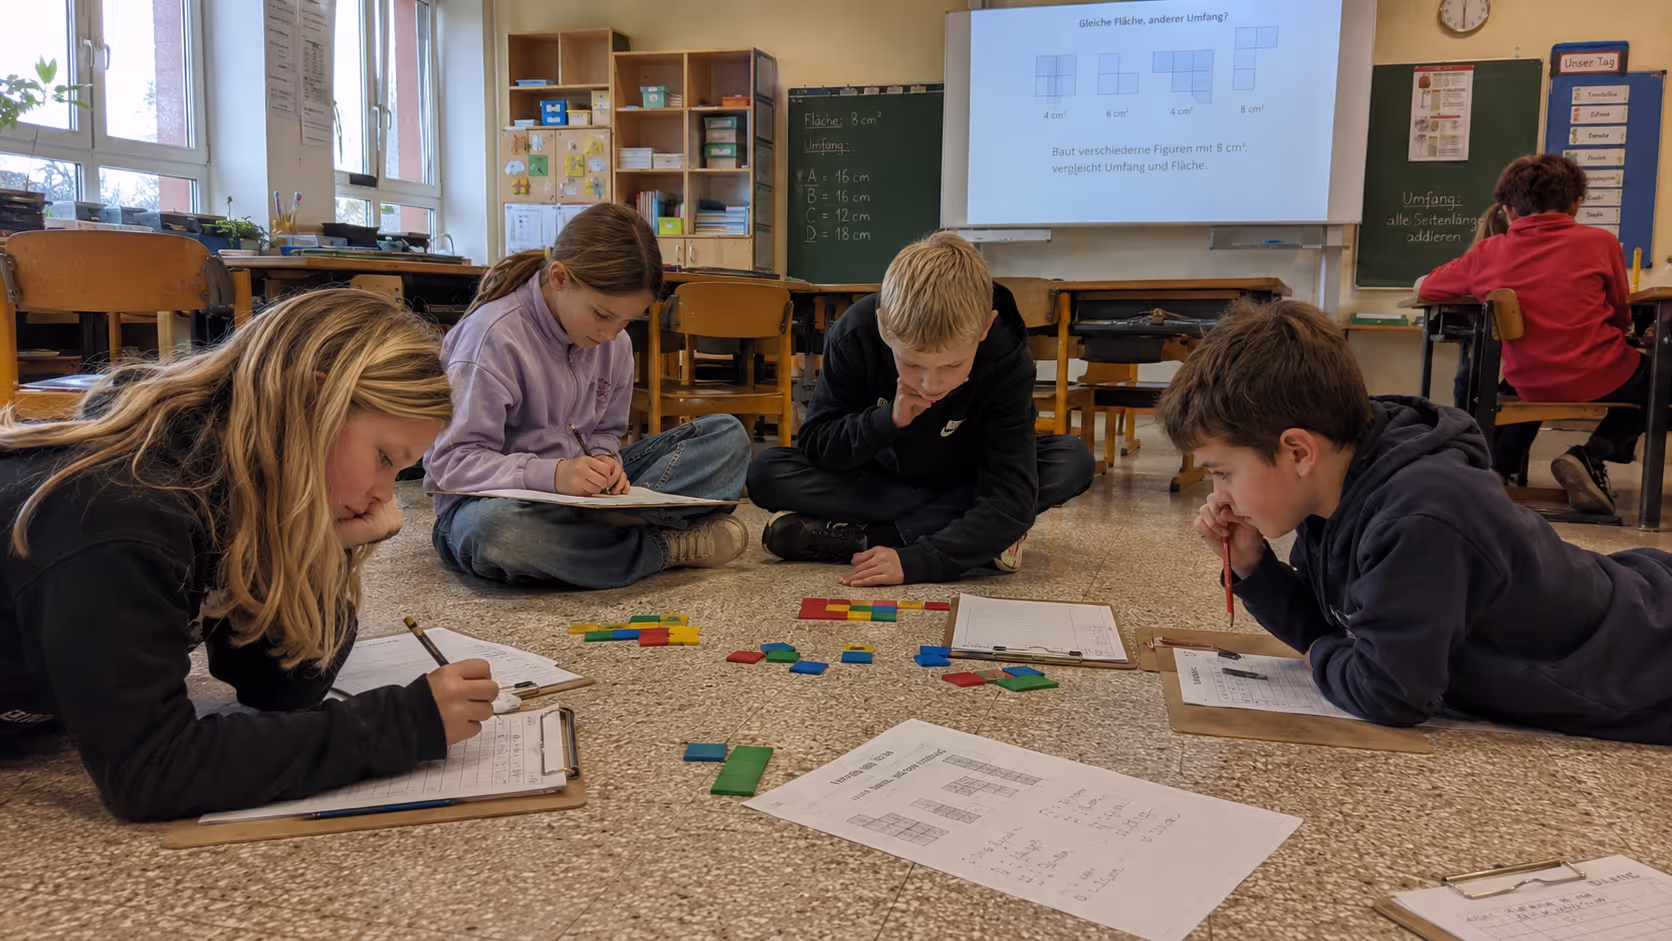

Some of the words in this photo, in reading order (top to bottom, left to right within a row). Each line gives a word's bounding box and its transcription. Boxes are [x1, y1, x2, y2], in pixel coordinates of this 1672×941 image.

[1079, 19, 1111, 28] Gleiche
[1114, 16, 1146, 26] Fläche,
[1148, 14, 1184, 24] anderer
[1187, 12, 1229, 23] Umfang?
[1564, 58, 1595, 68] Unser
[1597, 57, 1616, 69] Tag
[1043, 111, 1050, 119] 4
[1240, 105, 1246, 113] 8
[804, 112, 843, 129] Fläche:
[851, 111, 859, 126] 8
[861, 111, 882, 125] cm²
[803, 137, 851, 155] Umfang:
[1052, 147, 1076, 157] Baut
[1153, 144, 1193, 156] Figuren
[1195, 143, 1213, 153] mit
[1216, 143, 1223, 153] 8
[1104, 162, 1145, 173] Umfang
[1148, 161, 1169, 171] und
[1171, 160, 1208, 171] Fläche.
[807, 168, 817, 184] A
[835, 168, 850, 184] 16
[853, 174, 870, 185] cm
[807, 187, 817, 204] B
[835, 189, 849, 203] 16
[853, 194, 871, 203] cm
[1402, 191, 1463, 210] Umfang:
[805, 206, 816, 223] C
[835, 208, 850, 222] 12
[853, 213, 871, 222] cm
[1386, 212, 1410, 226] alle
[805, 225, 817, 240] D
[834, 226, 850, 241] 18
[853, 231, 871, 240] cm
[1407, 229, 1462, 242] addieren
